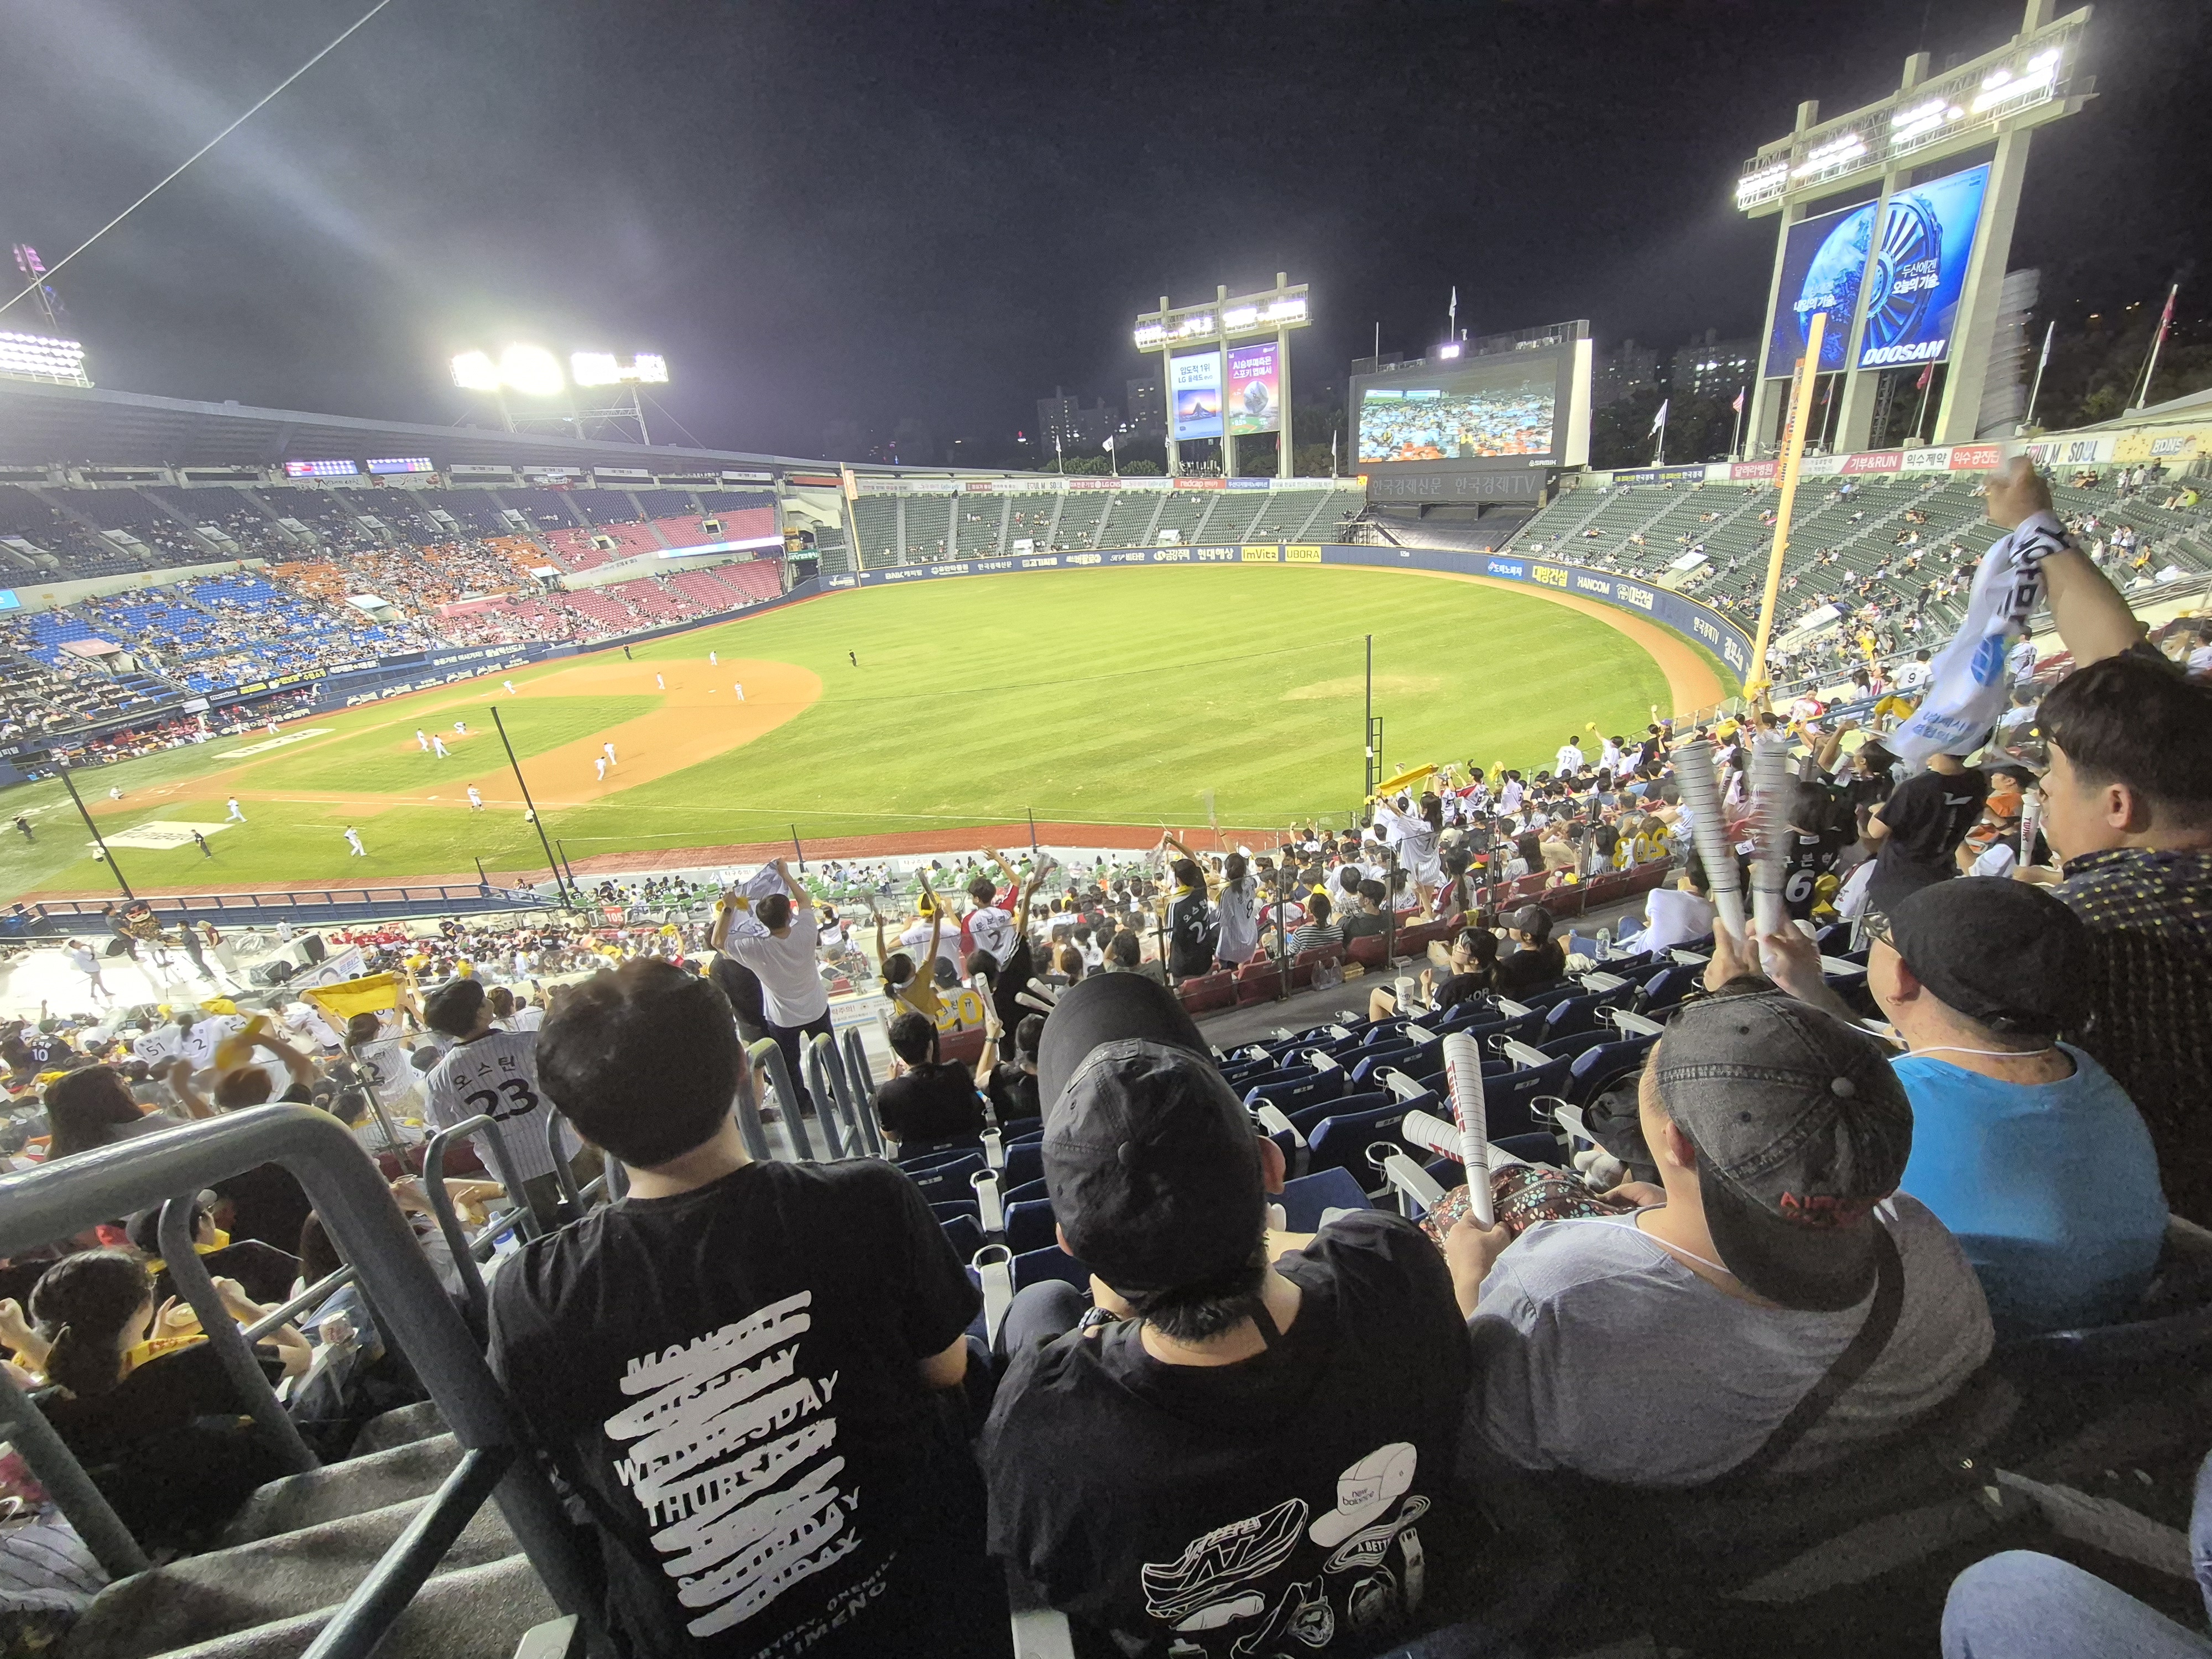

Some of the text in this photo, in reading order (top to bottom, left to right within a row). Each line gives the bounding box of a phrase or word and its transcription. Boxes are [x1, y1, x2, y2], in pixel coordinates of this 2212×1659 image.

[1902, 258, 1937, 277] 두산에겐
[1892, 279, 1918, 294] 오늘의
[1794, 296, 1817, 312] 내일의
[1180, 364, 1210, 375] 압도적 1위
[2068, 440, 2098, 462] SOUL
[2151, 437, 2183, 455] BDNS
[1850, 455, 1897, 471] 기부&RUN
[1907, 452, 1947, 467] 익수제약
[1682, 471, 1703, 479] 한국경제
[1735, 463, 1773, 477] 달려라병원
[1180, 480, 1203, 489] redcap
[1373, 475, 1536, 495] 한국경제신문 한국경제TV
[1197, 547, 1234, 561] 현대해상
[1287, 550, 1319, 559] UBORA
[977, 561, 1013, 570] 한국경제신문
[1494, 564, 1522, 577] 도미노피자
[885, 570, 923, 580] BNK캐피탈
[1532, 565, 1568, 587] 대방건설
[1577, 576, 1610, 595] HANCOM
[1907, 673, 1916, 684] 9
[211, 691, 237, 700] mentos
[1563, 755, 1573, 764] 17
[1786, 869, 1815, 902] 6
[606, 912, 624, 922] 105
[988, 930, 1004, 951] 2
[146, 1042, 166, 1056] 51
[192, 1039, 207, 1050] 2
[32, 1048, 49, 1061] 10
[454, 1055, 516, 1091] 오스틴
[464, 1078, 539, 1123] 23
[1358, 1543, 1364, 1552] A
